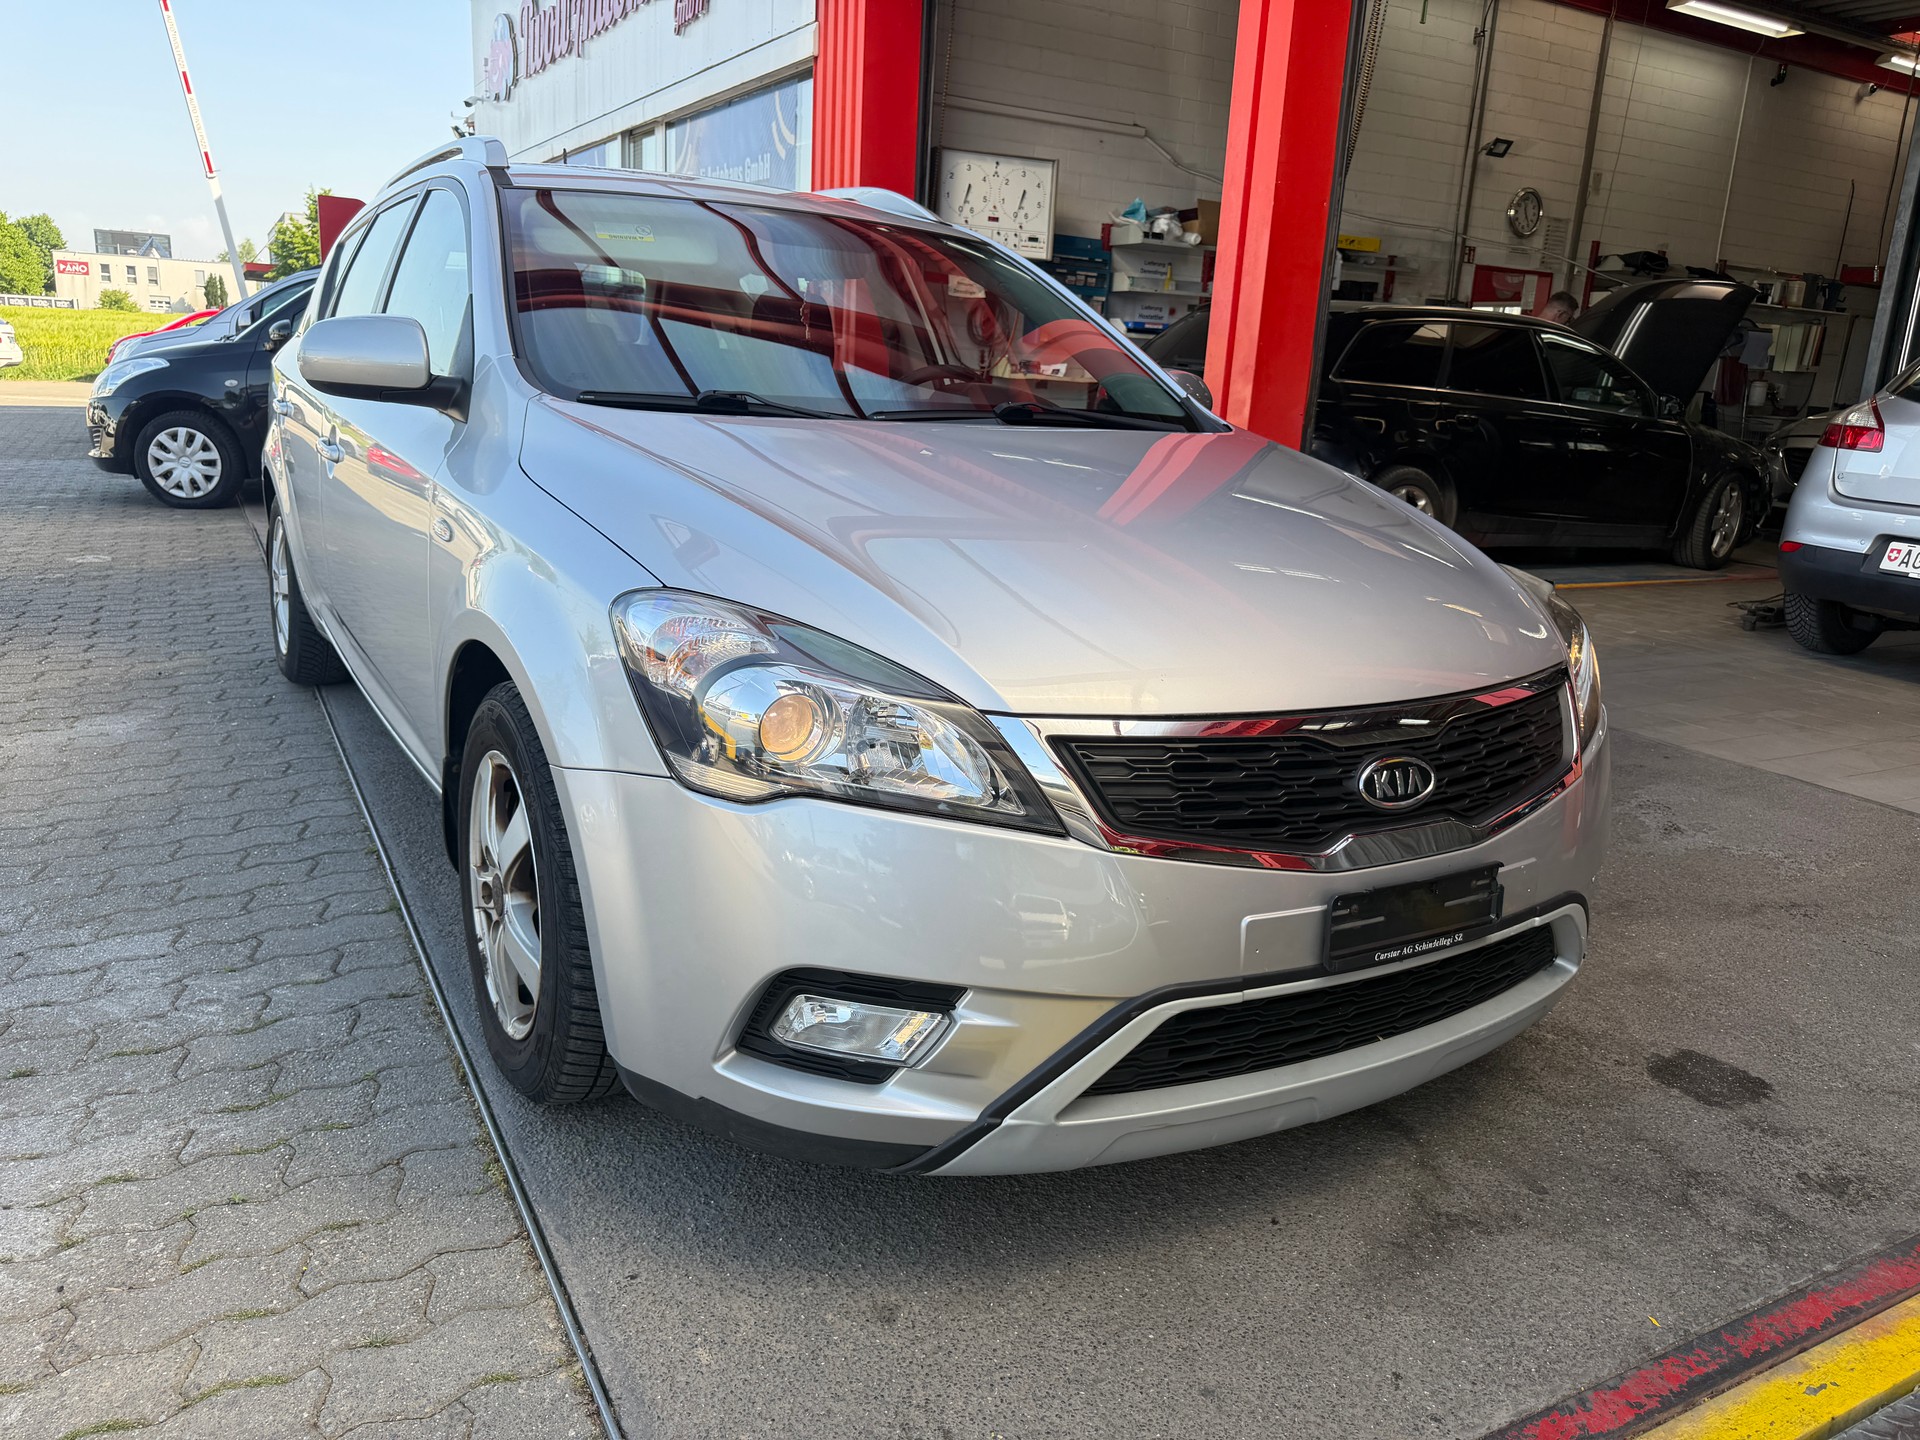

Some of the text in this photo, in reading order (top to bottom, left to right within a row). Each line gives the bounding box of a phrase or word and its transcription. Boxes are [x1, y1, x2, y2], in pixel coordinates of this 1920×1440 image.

[744, 152, 770, 182] GmbH
[1144, 260, 1166, 268] Lieferung
[1372, 766, 1425, 799] KIA
[1374, 949, 1402, 961] Carstar
[1402, 945, 1413, 955] AG
[1414, 936, 1454, 952] Schindellegi
